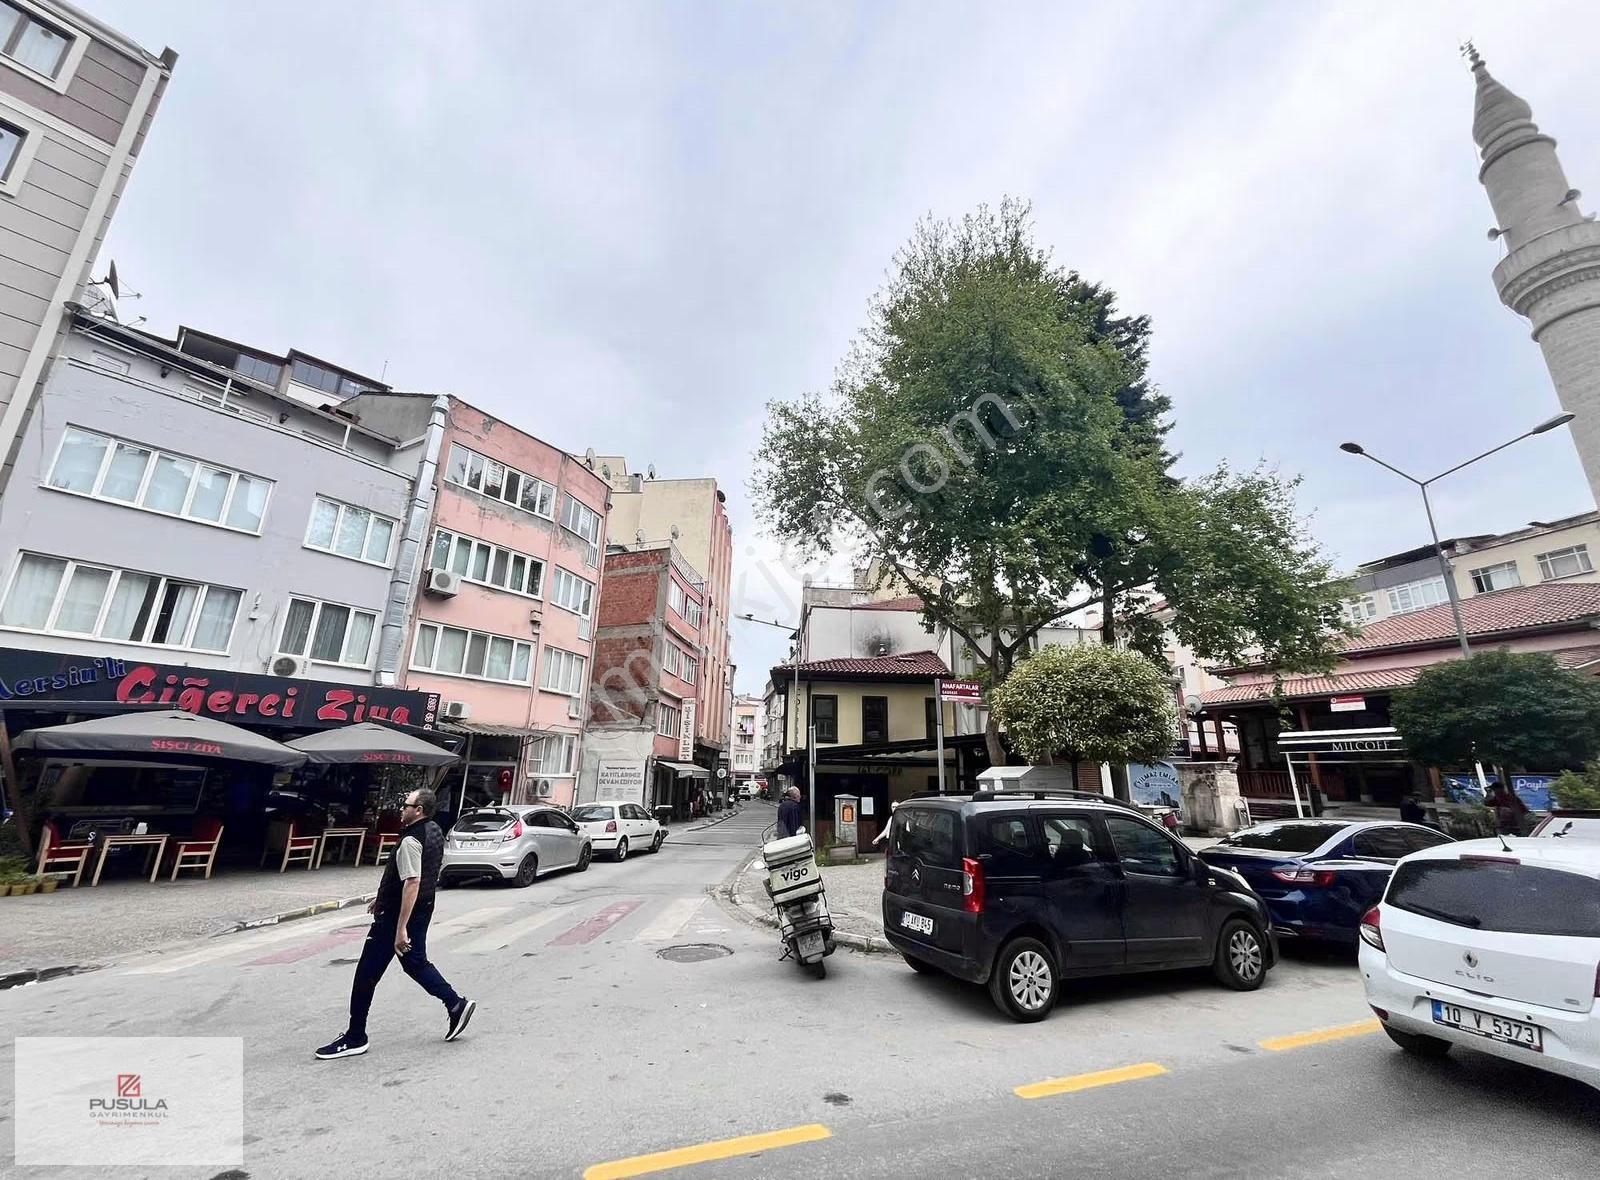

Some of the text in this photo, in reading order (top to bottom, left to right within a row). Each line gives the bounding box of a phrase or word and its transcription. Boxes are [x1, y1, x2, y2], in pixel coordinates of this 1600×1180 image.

[941, 683, 979, 691] ANAFARTALAR
[781, 868, 809, 881] vigo
[1455, 969, 1494, 983] CLIO
[1445, 1006, 1461, 1023] 10
[1473, 1012, 1482, 1029] V
[1493, 1018, 1535, 1044] 5373
